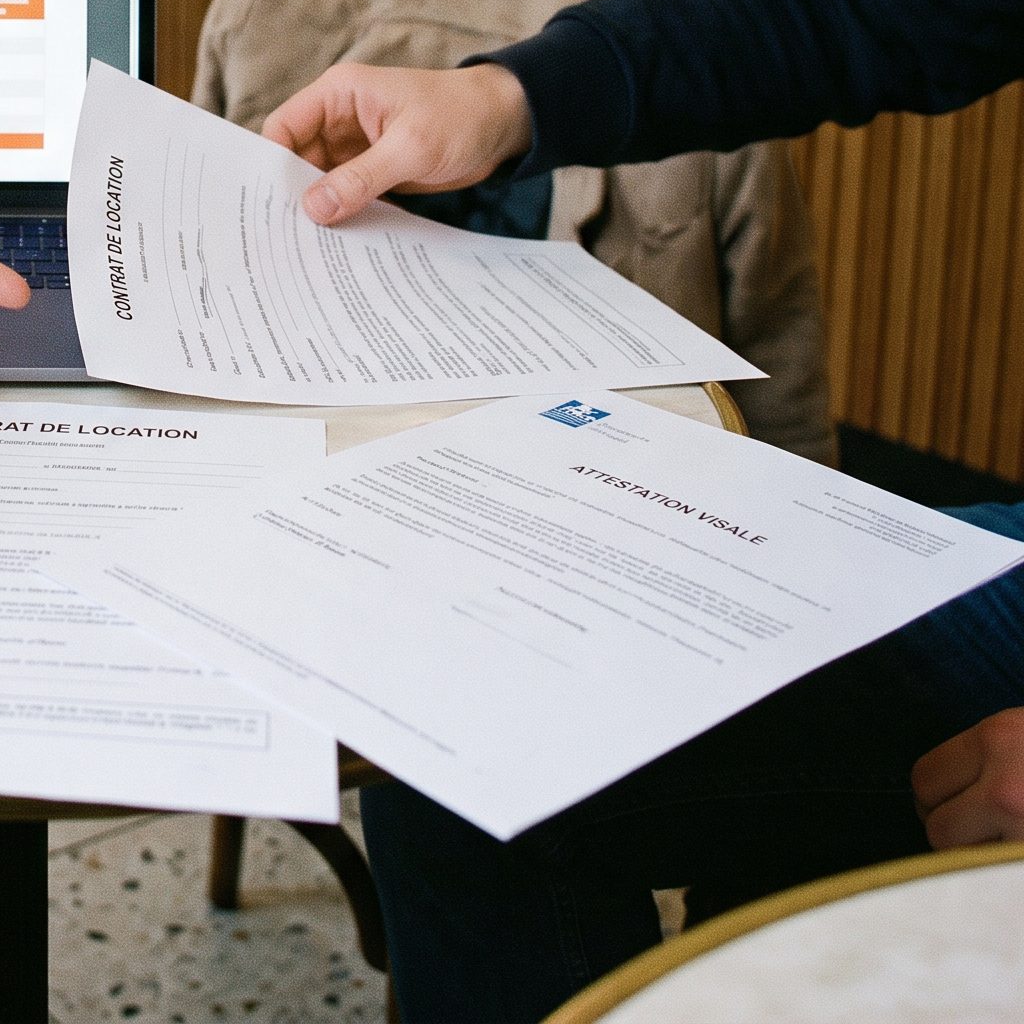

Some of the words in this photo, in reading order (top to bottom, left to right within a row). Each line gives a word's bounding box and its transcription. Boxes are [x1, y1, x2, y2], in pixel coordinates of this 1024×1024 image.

[106, 155, 125, 232] LOCATION
[106, 233, 123, 255] DE
[107, 255, 133, 321] CONTRAT
[40, 423, 70, 434] DE
[78, 425, 198, 440] LOCATION
[569, 465, 696, 515] ATTESTATION
[698, 512, 769, 546] VISALE
